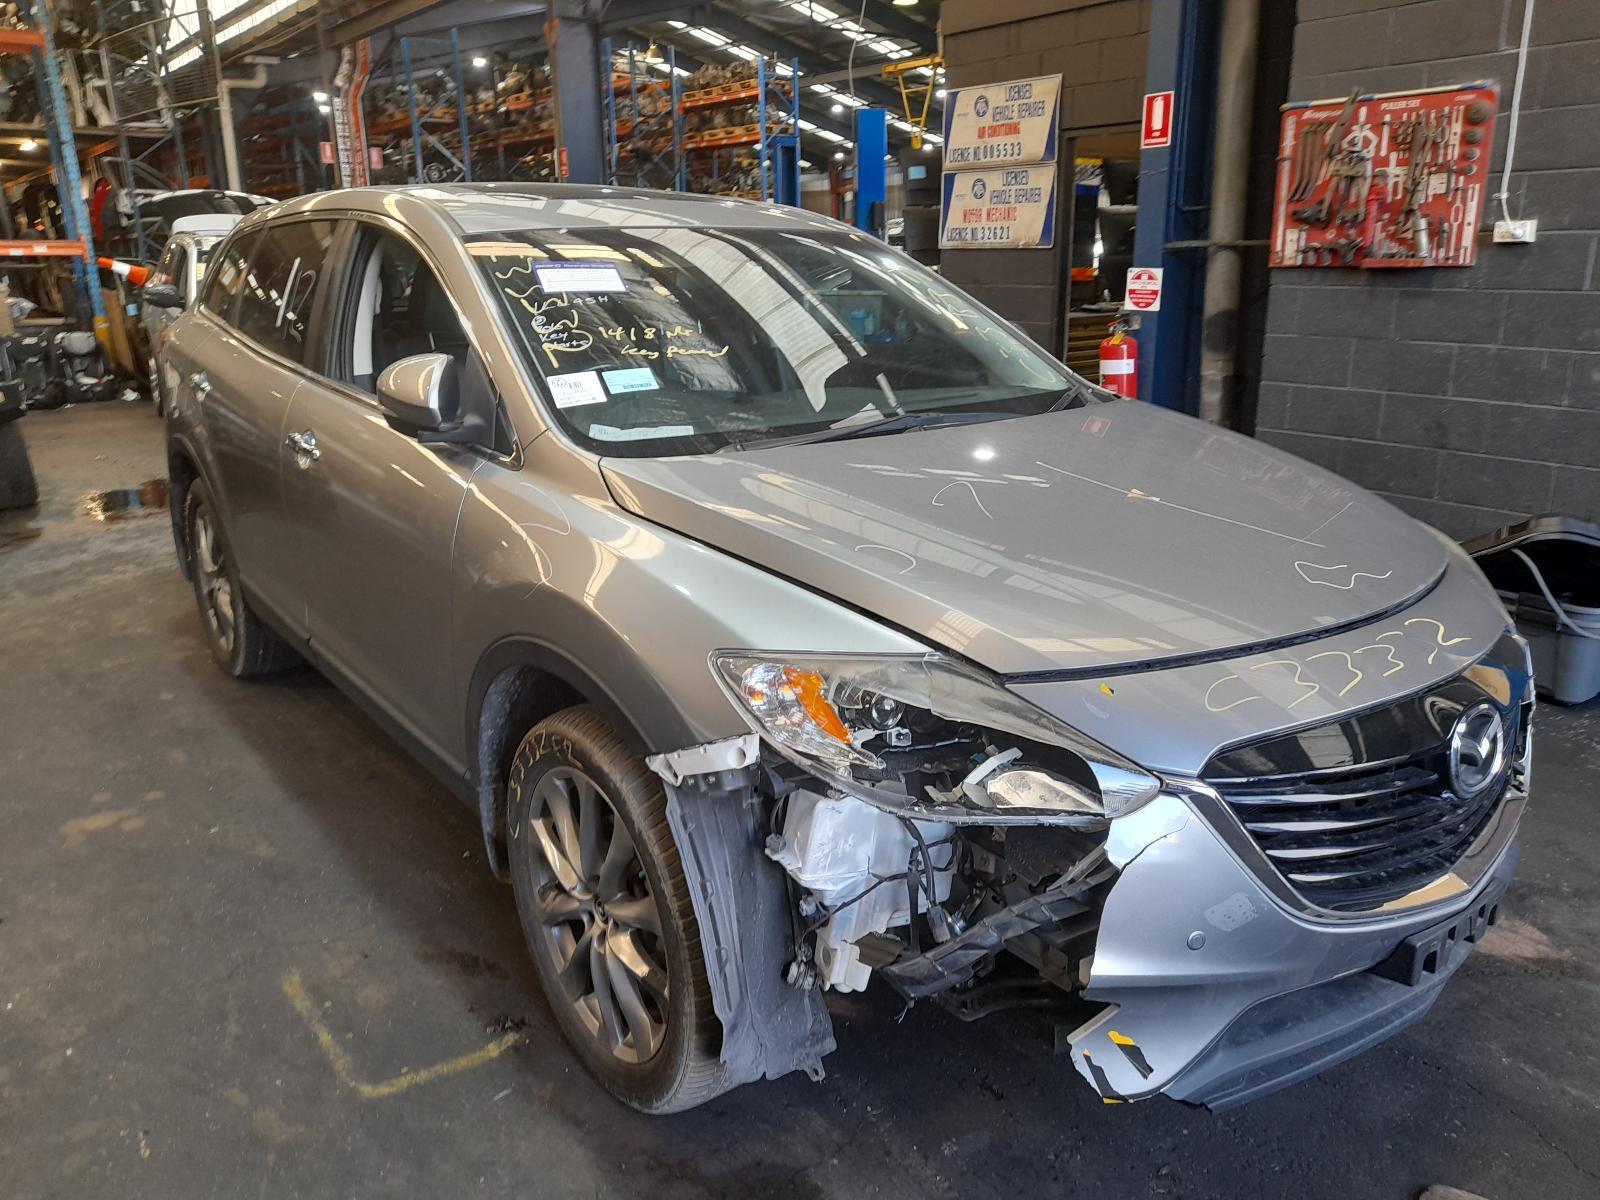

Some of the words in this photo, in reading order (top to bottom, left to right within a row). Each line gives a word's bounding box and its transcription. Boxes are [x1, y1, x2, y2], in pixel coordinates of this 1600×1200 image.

[1005, 83, 1032, 102] LICENSED
[992, 104, 1014, 122] VEHICLE
[1018, 100, 1045, 118] REPAIRER
[977, 126, 986, 139] AIR
[988, 122, 1020, 138] CONDITIONING
[983, 142, 1022, 160] 005533
[1002, 170, 1028, 187] LICENSED
[990, 188, 1012, 205] VEHICLE
[1015, 187, 1042, 204] REPAIRER
[963, 208, 982, 224] MOTOR
[986, 206, 1017, 223] MECHANIC
[980, 226, 1010, 240] 32621
